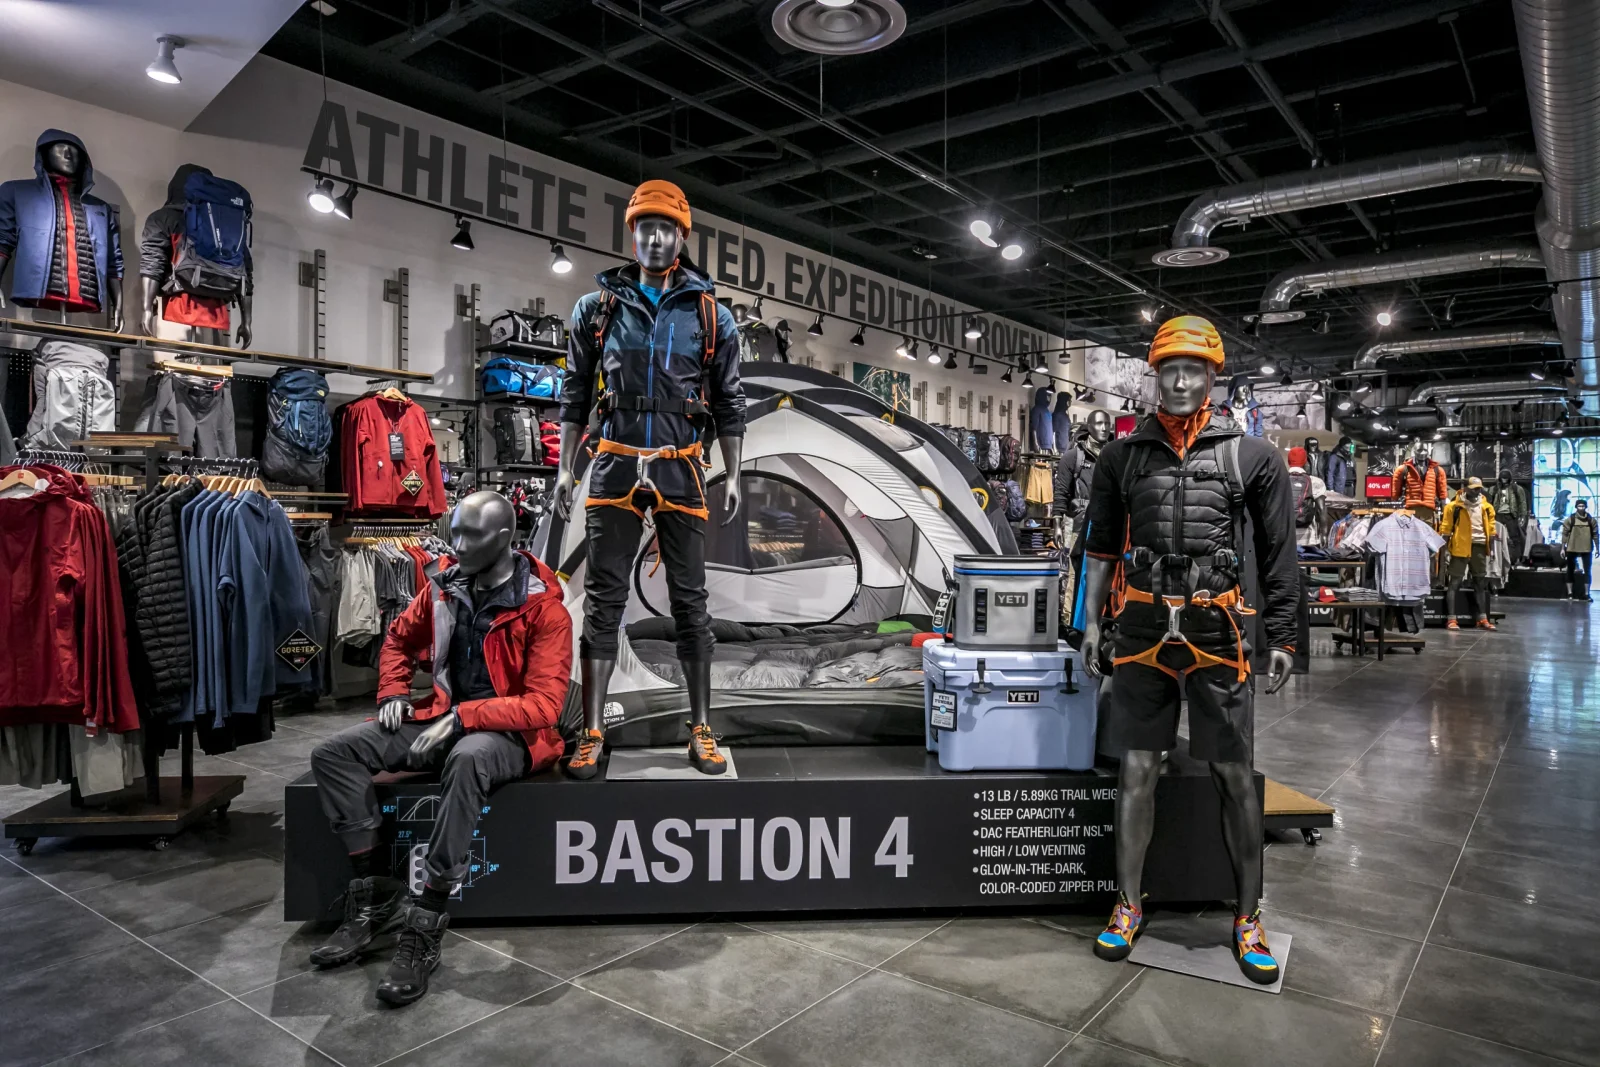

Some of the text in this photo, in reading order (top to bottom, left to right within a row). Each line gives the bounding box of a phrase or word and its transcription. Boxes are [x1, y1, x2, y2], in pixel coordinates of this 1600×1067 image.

[303, 100, 1043, 368] ATHLETE TTED. EXPEDITION PROVEN
[998, 595, 1025, 604] YETI
[281, 646, 316, 654] GORE-TEX
[1009, 692, 1038, 702] YETI
[981, 789, 1118, 802] 13 LB / 5.89KG TRAIL WEIG
[980, 808, 1075, 820] SLEEP CAPACITY 4
[981, 827, 1003, 839] DAC
[1005, 826, 1080, 838] FEATHERLIGHT
[555, 816, 914, 884] BASTION 4
[980, 844, 1086, 857] HIGH / LOW VENTING
[980, 863, 1086, 875] GLOW-IN-THE-DARK,
[980, 880, 1119, 894] COLOR-CODED ZIPPER PUL
